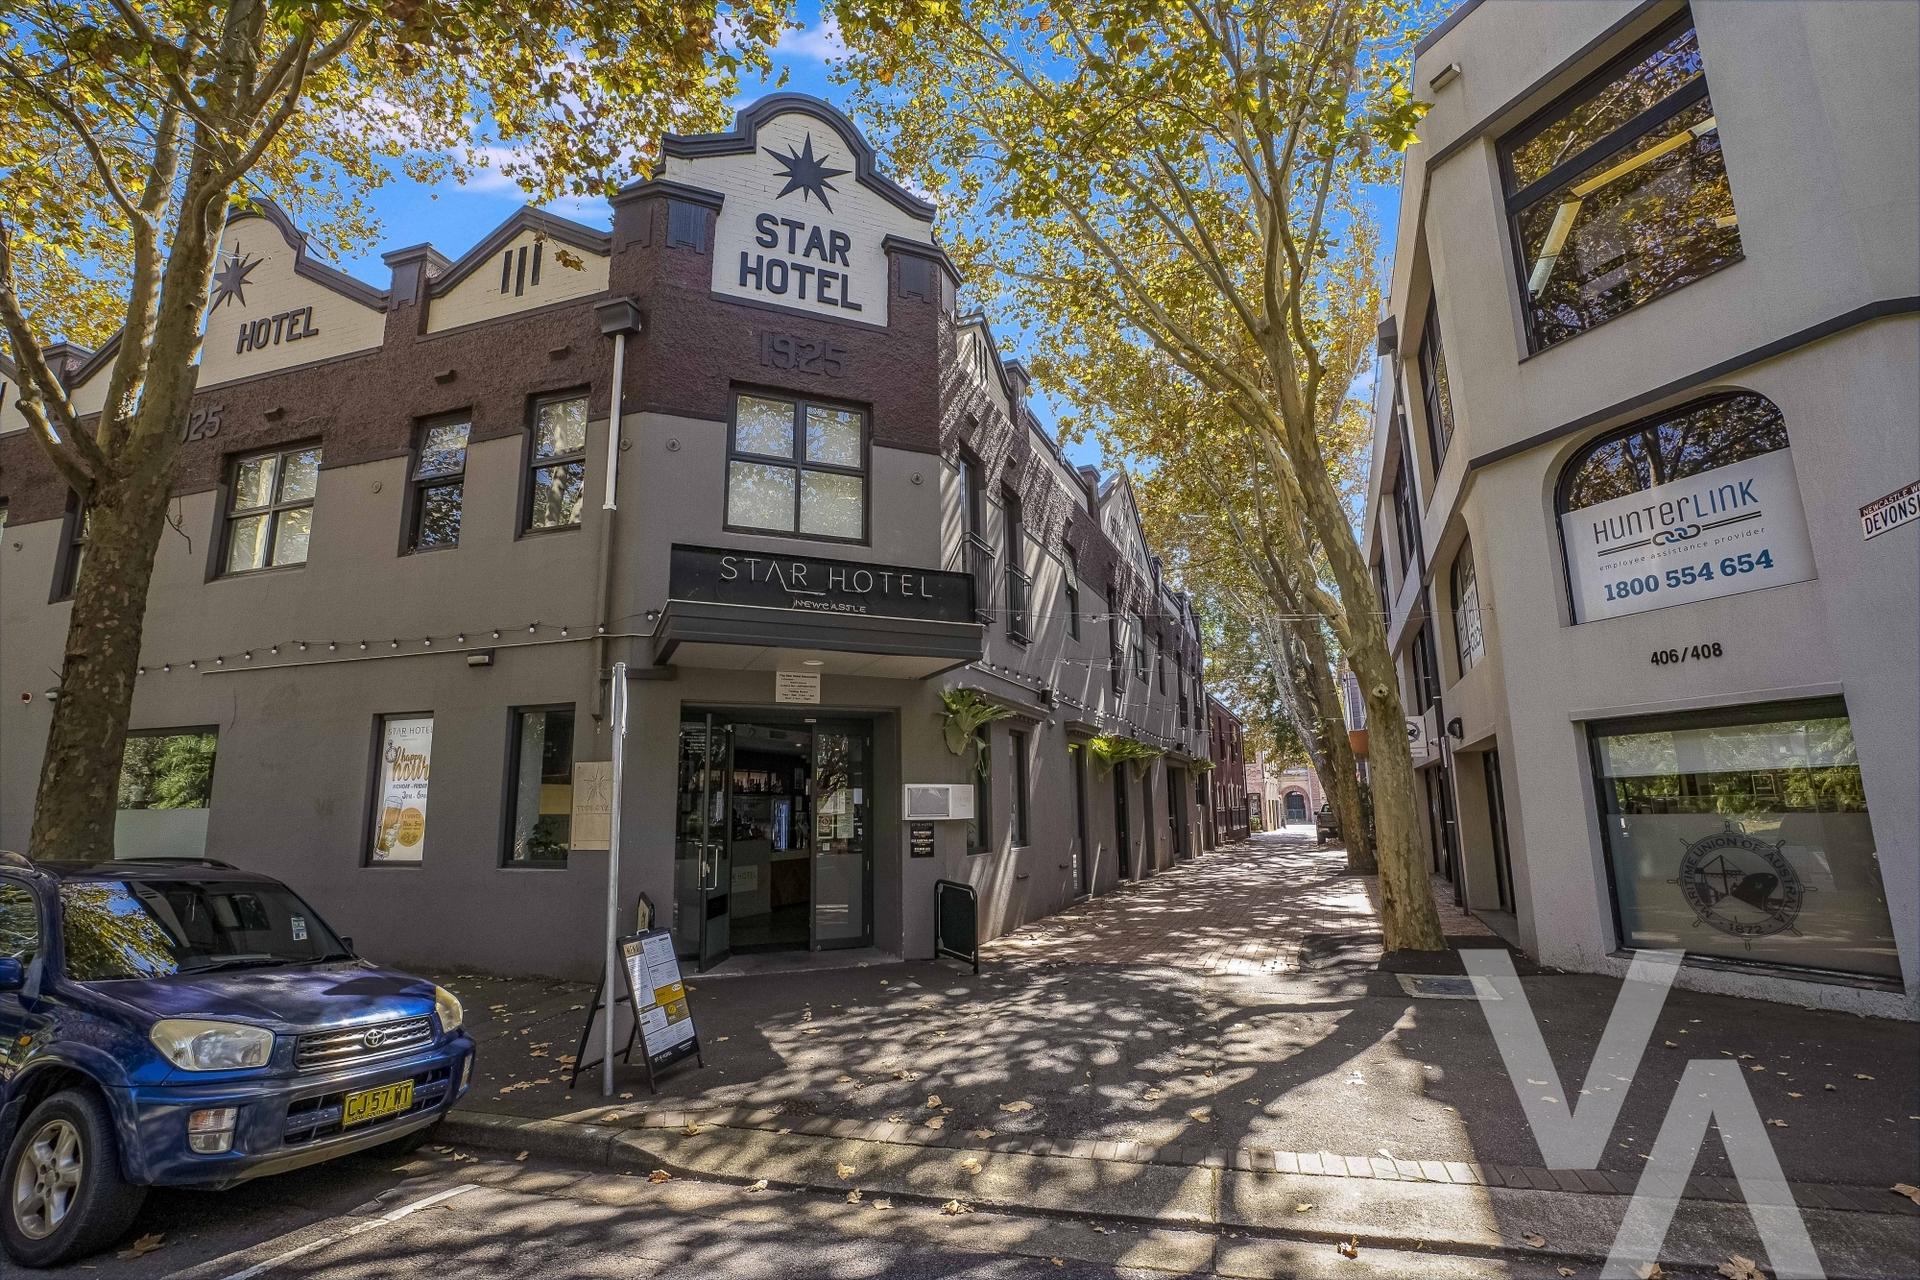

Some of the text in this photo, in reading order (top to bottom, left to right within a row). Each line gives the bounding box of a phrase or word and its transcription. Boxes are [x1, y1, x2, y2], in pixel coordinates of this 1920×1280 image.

[755, 213, 851, 267] STAR
[739, 251, 863, 312] HOTEL
[236, 306, 319, 354] HOTEL
[760, 330, 848, 378] 1925
[1864, 489, 1909, 516] NEWCASTLE
[1600, 528, 1765, 571] employee assistance provider
[720, 556, 933, 597] STAR HOTEL
[1604, 549, 1774, 601] 1800 554 654
[793, 599, 867, 613] NEWCASTLE
[1650, 642, 1723, 666] 406/408
[1684, 838, 1798, 924] MARITIME UNION OF AUSTRALIA
[1729, 922, 1764, 934] 1872
